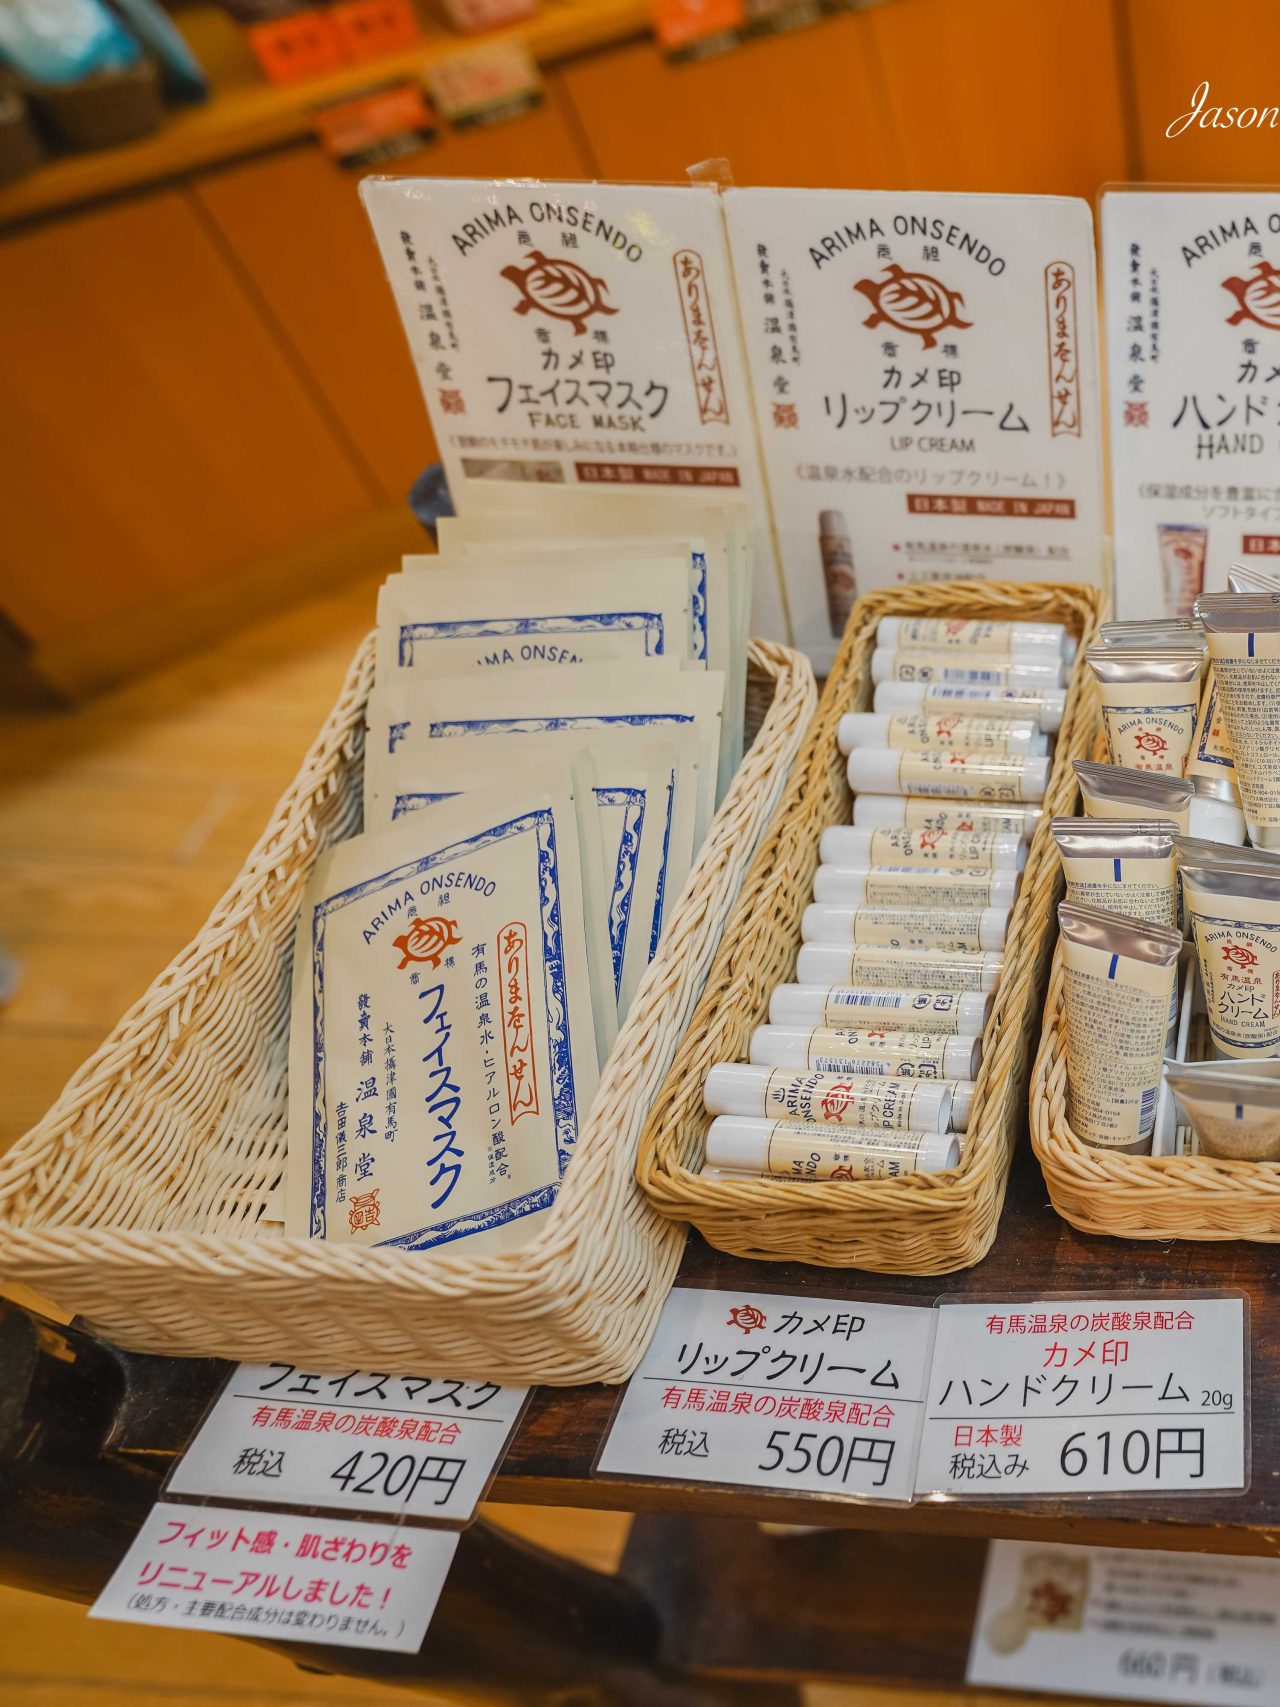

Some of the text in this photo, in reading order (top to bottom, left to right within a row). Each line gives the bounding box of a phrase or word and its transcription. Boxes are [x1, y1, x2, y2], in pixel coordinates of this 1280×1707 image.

[451, 202, 643, 263] ARIMA ONSENDO
[809, 215, 1006, 276] ARIMA ONSENDO
[1180, 214, 1259, 268] ARIMA
[541, 350, 616, 375] カメ印
[882, 366, 962, 392] カメ印
[487, 375, 669, 419] フェイスマスク
[824, 393, 1030, 433] リップクリーム
[529, 412, 646, 432] FACE MASK
[890, 436, 975, 453] LIP CREAM
[1196, 434, 1264, 461] HAND
[1014, 500, 1029, 514] IN
[1034, 501, 1070, 516] JAPAN
[1116, 716, 1184, 736] ARIMA ONSENDO
[362, 872, 497, 946] ARIMA ONSENDO
[1204, 931, 1277, 953] ARIMA ONSENDO
[1220, 973, 1262, 985] 有馬温泉
[1227, 983, 1254, 992] カメ印
[1219, 1002, 1268, 1019] クリーム
[1220, 991, 1265, 1006] ハンド
[1221, 1016, 1237, 1026] HAND
[418, 983, 464, 1210] フェイスマスク
[787, 1076, 806, 1116] ARIMA
[883, 1082, 901, 1118] CREAM
[354, 1076, 379, 1182] 温泉堂
[773, 1311, 865, 1341] カメ印
[986, 1310, 1195, 1335] 有馬温泉の炭酸泉配合
[677, 1342, 900, 1389] リップクリーム
[1043, 1339, 1129, 1368] カメ印
[259, 1363, 501, 1411] フェイスマスク
[939, 1372, 1233, 1409] ハンドクリーム 20g
[251, 1406, 462, 1445] 有馬温泉の炭酸泉配合
[661, 1385, 895, 1429] 有馬温泉の炭酸泉配合
[950, 1428, 1204, 1480] 税込み 610円
[954, 1424, 1023, 1448] 日本製
[658, 1428, 895, 1486] 税込 550円
[232, 1447, 467, 1506] 税込 420円
[157, 1520, 414, 1569] フィット感・肌ざわりを
[138, 1561, 392, 1610] リニューアルしました！
